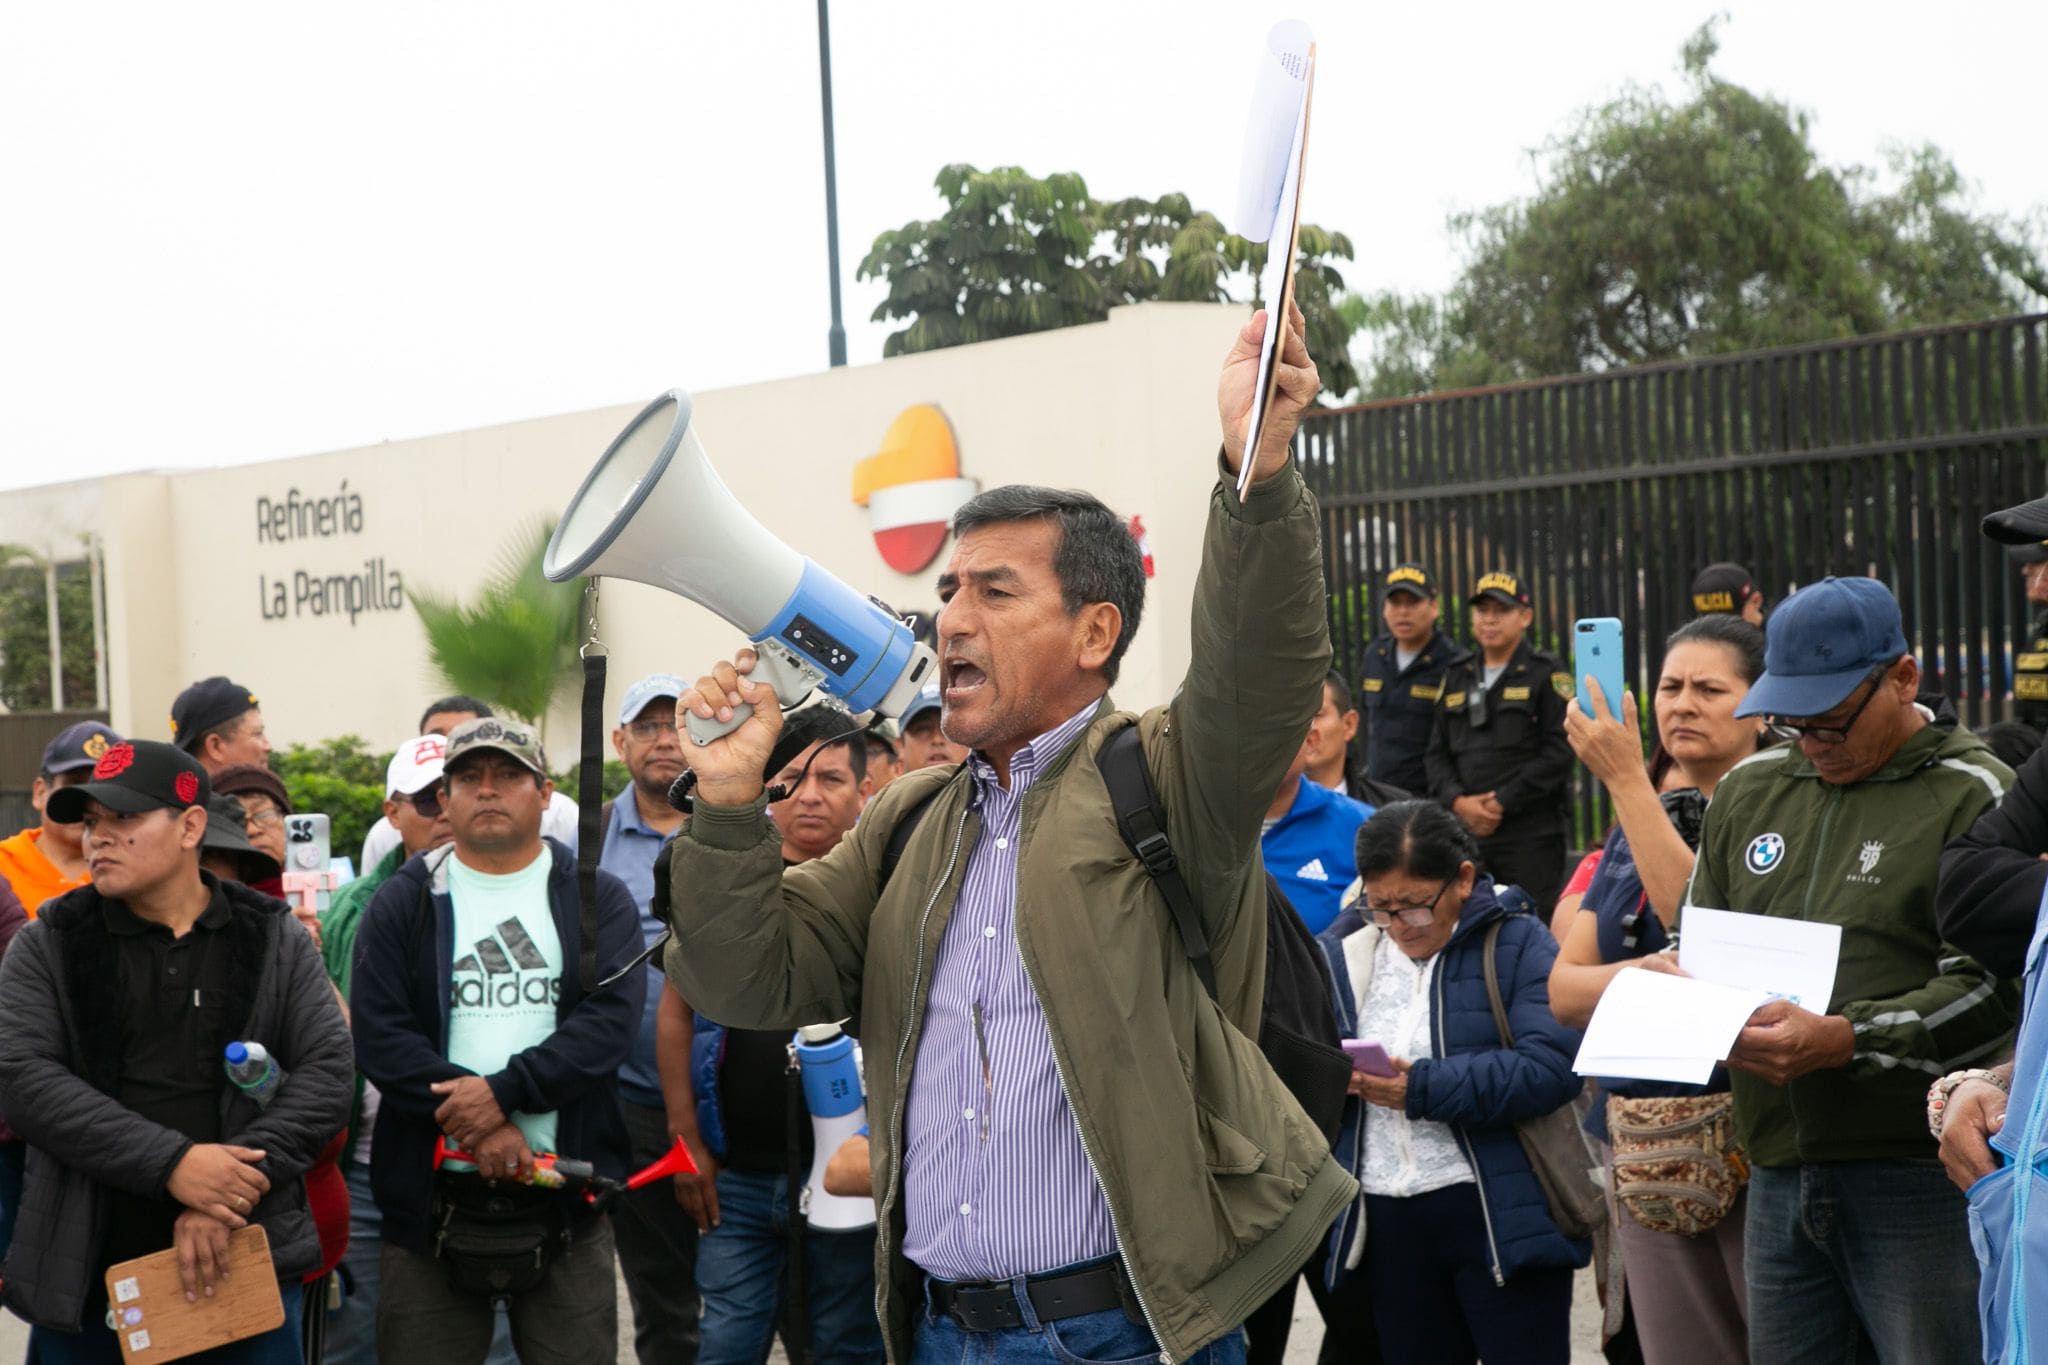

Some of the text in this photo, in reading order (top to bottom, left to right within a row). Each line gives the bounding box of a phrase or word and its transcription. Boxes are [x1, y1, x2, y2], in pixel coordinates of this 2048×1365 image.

[257, 478, 363, 543] Refinería
[260, 557, 403, 626] La Pampilla
